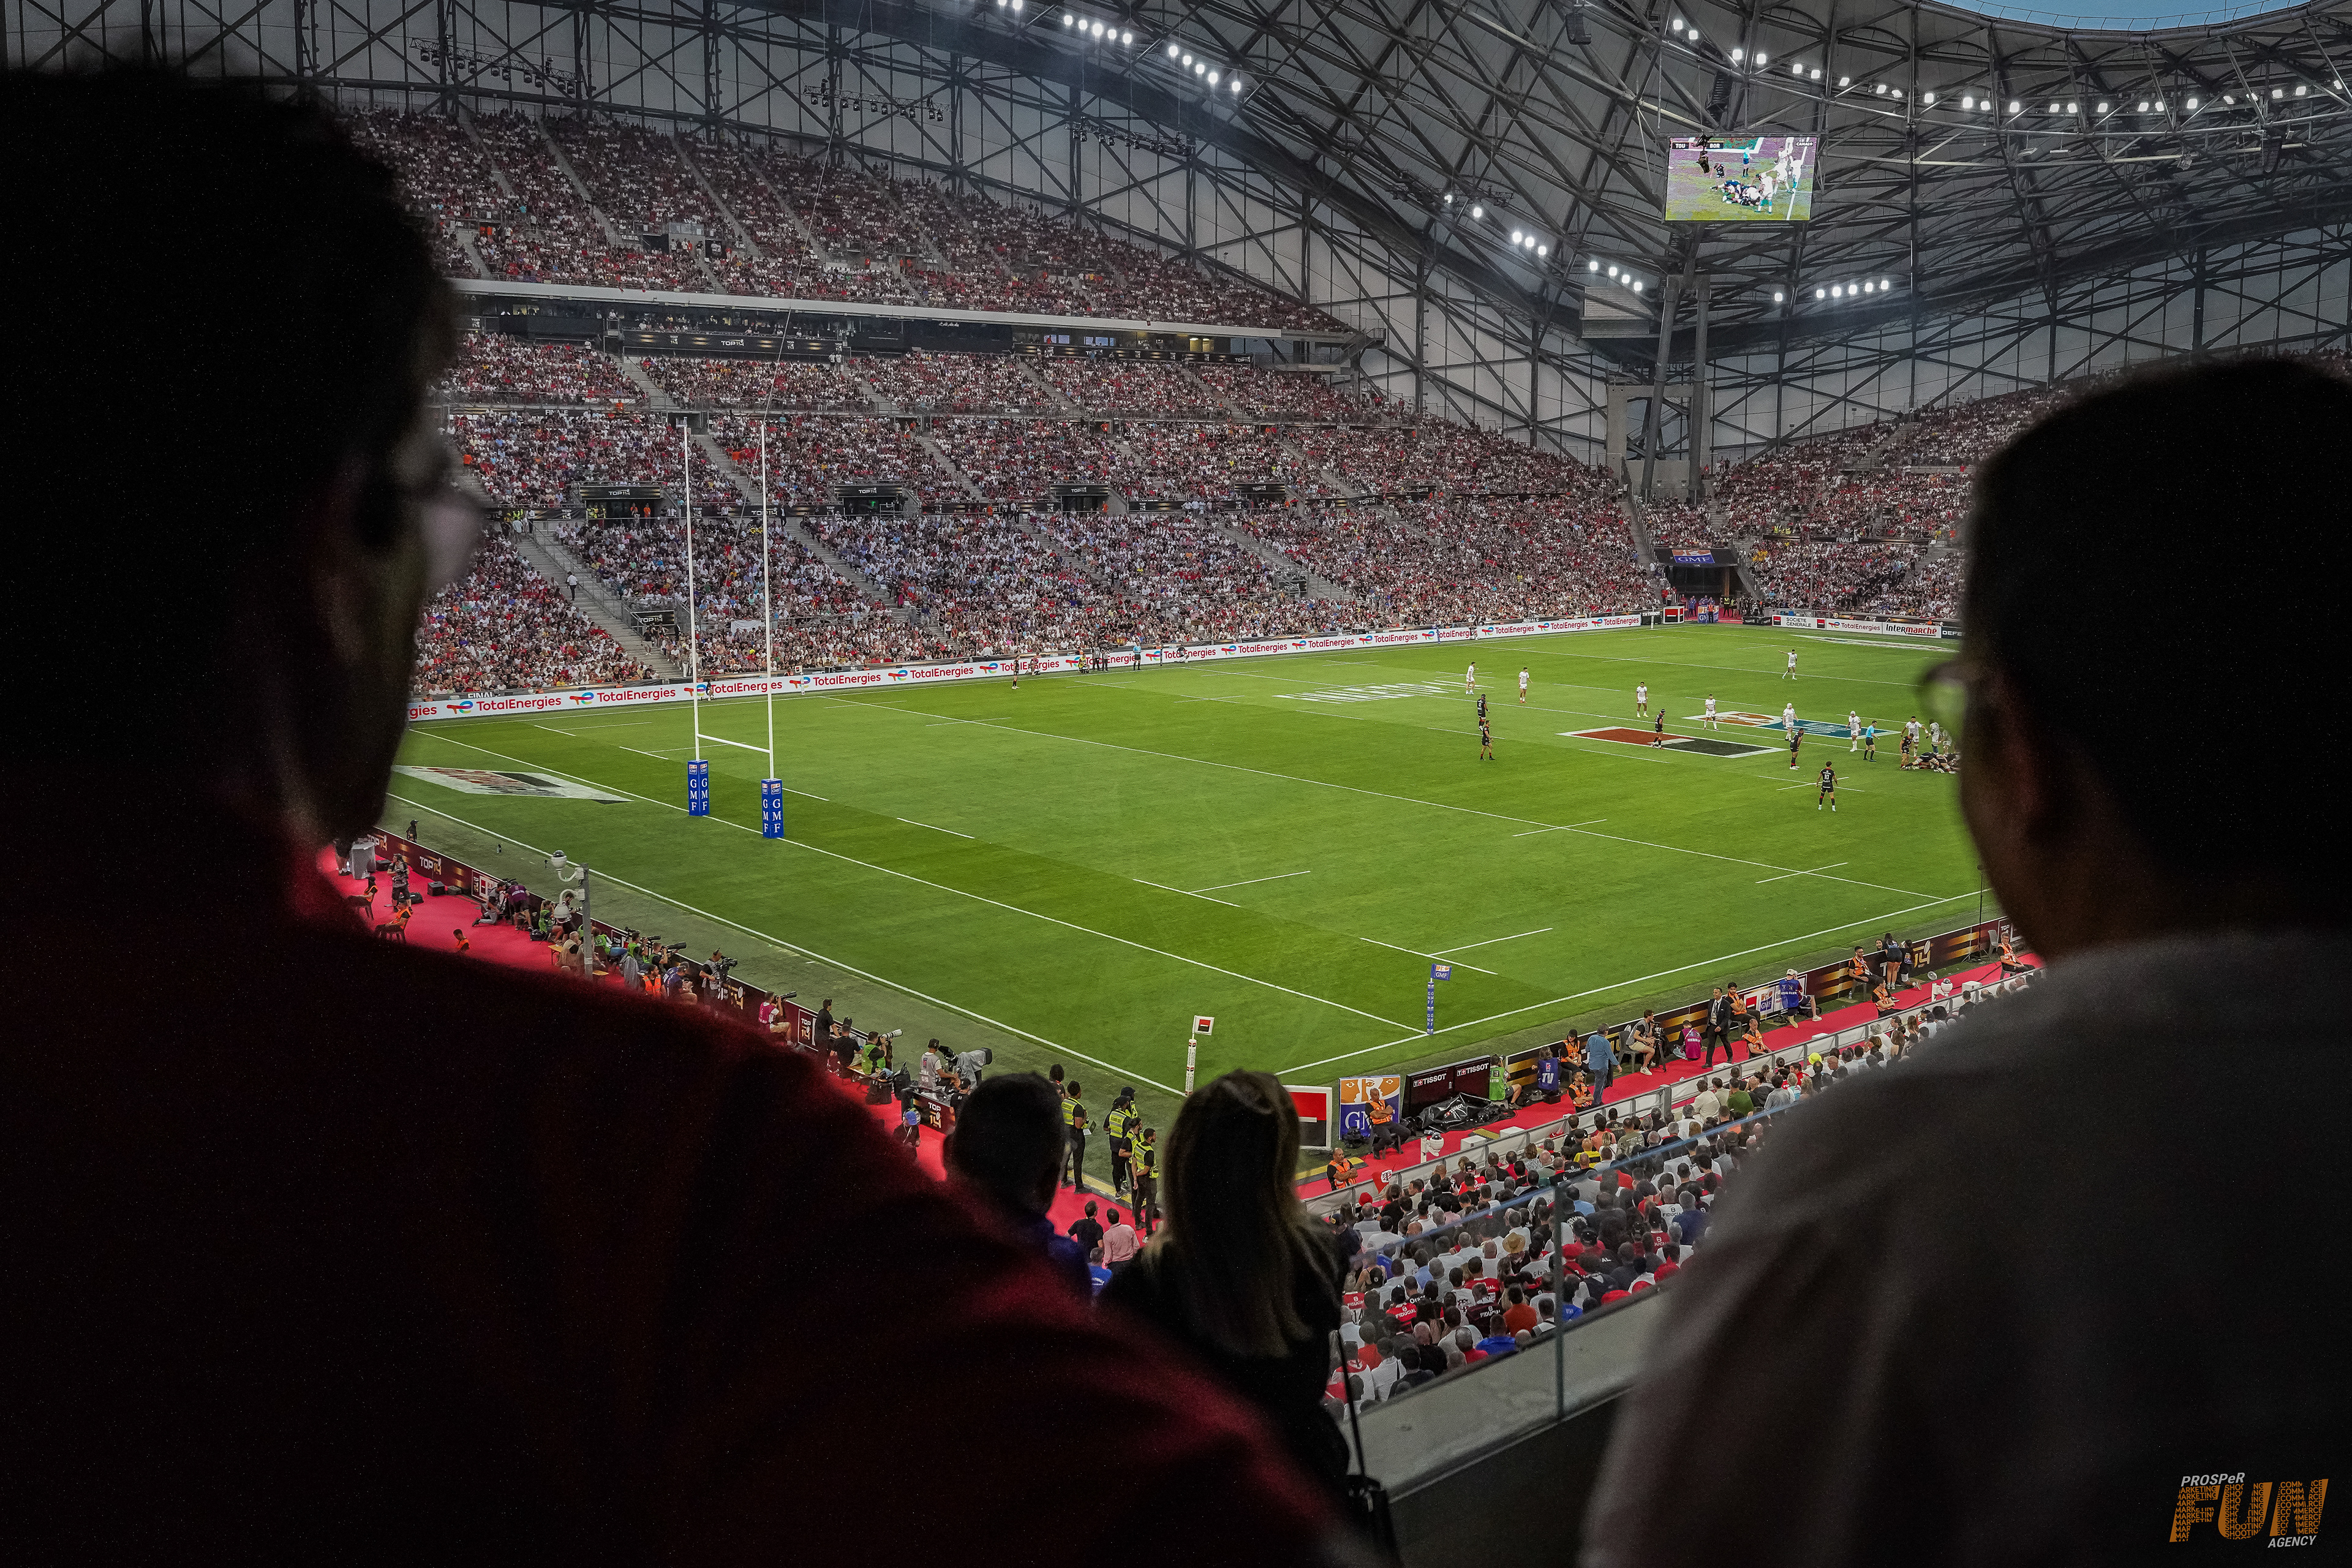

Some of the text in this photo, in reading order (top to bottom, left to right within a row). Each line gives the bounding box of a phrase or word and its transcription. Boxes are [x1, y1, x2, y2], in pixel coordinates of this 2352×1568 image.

[1550, 621, 1588, 630] TotalEnergies
[1604, 617, 1639, 626] TotalEnergies
[1841, 622, 1880, 631] TotalEnergies
[1494, 625, 1534, 635] TotalEnergies
[1886, 624, 1937, 636] Intermarché
[1308, 638, 1354, 648] TotalEnergies
[1374, 633, 1418, 643] TotalEnergies
[1238, 643, 1287, 654] TotalEnergies
[910, 666, 974, 679] TotalEnergies
[812, 673, 881, 686] TotalEnergies
[710, 682, 783, 694] TotalEnerges
[597, 688, 676, 703] TotalEnergies
[476, 696, 562, 712] TotalEnergies
[420, 856, 442, 875] TOP14
[1466, 1063, 1489, 1074] TISSOT
[1423, 1074, 1447, 1086] TISSOT
[1542, 1072, 1554, 1084] TV
[929, 1102, 941, 1112] TOP
[1450, 1103, 1464, 1114] TISSOT
[1395, 1308, 1417, 1319] FIDUCIAL
